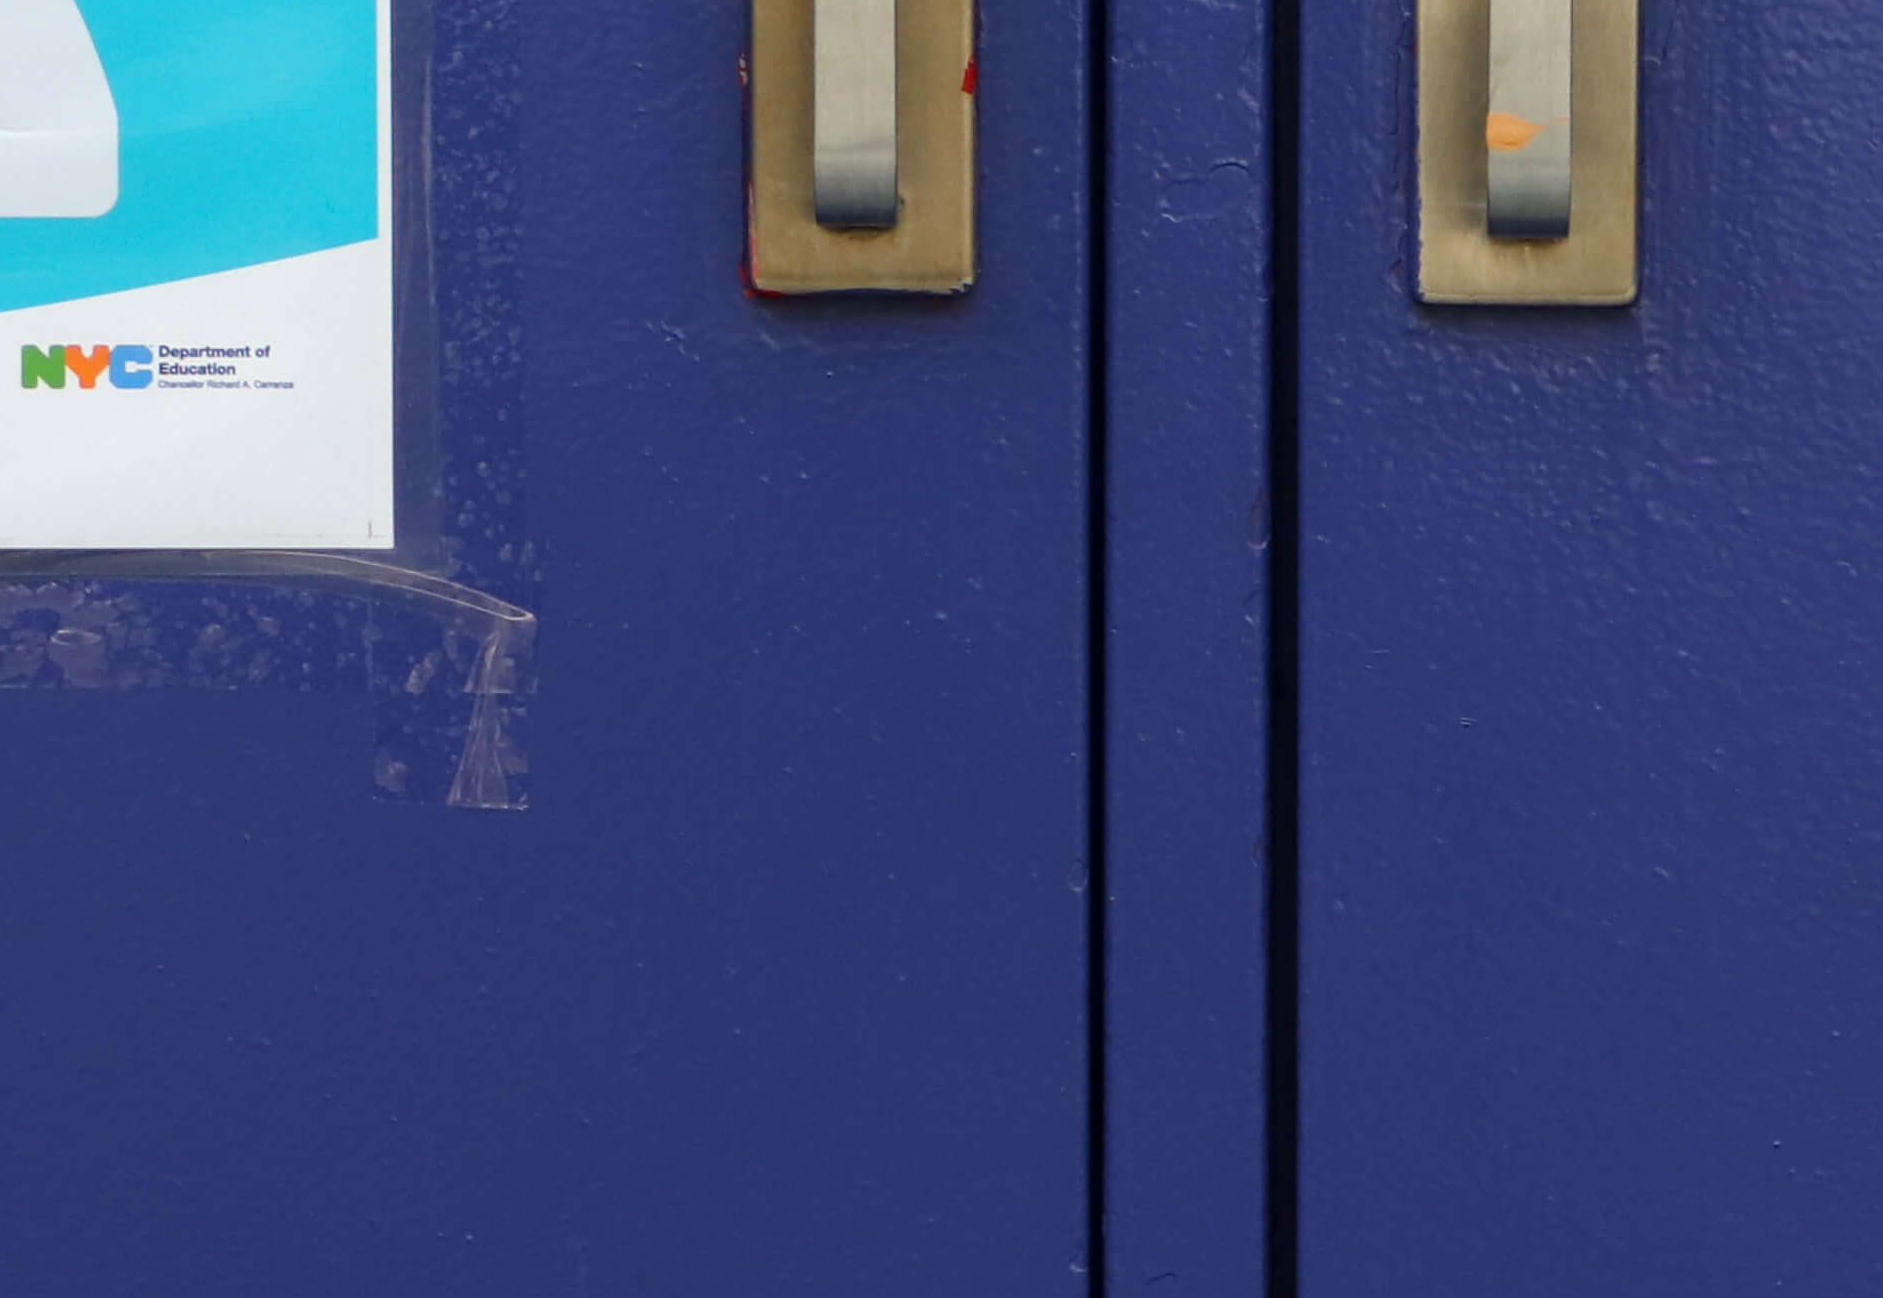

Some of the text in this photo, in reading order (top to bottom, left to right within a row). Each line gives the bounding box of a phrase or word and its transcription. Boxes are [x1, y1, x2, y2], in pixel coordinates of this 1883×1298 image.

[158, 345, 270, 359] Department of
[21, 344, 153, 389] NYC
[158, 362, 236, 375] Education
